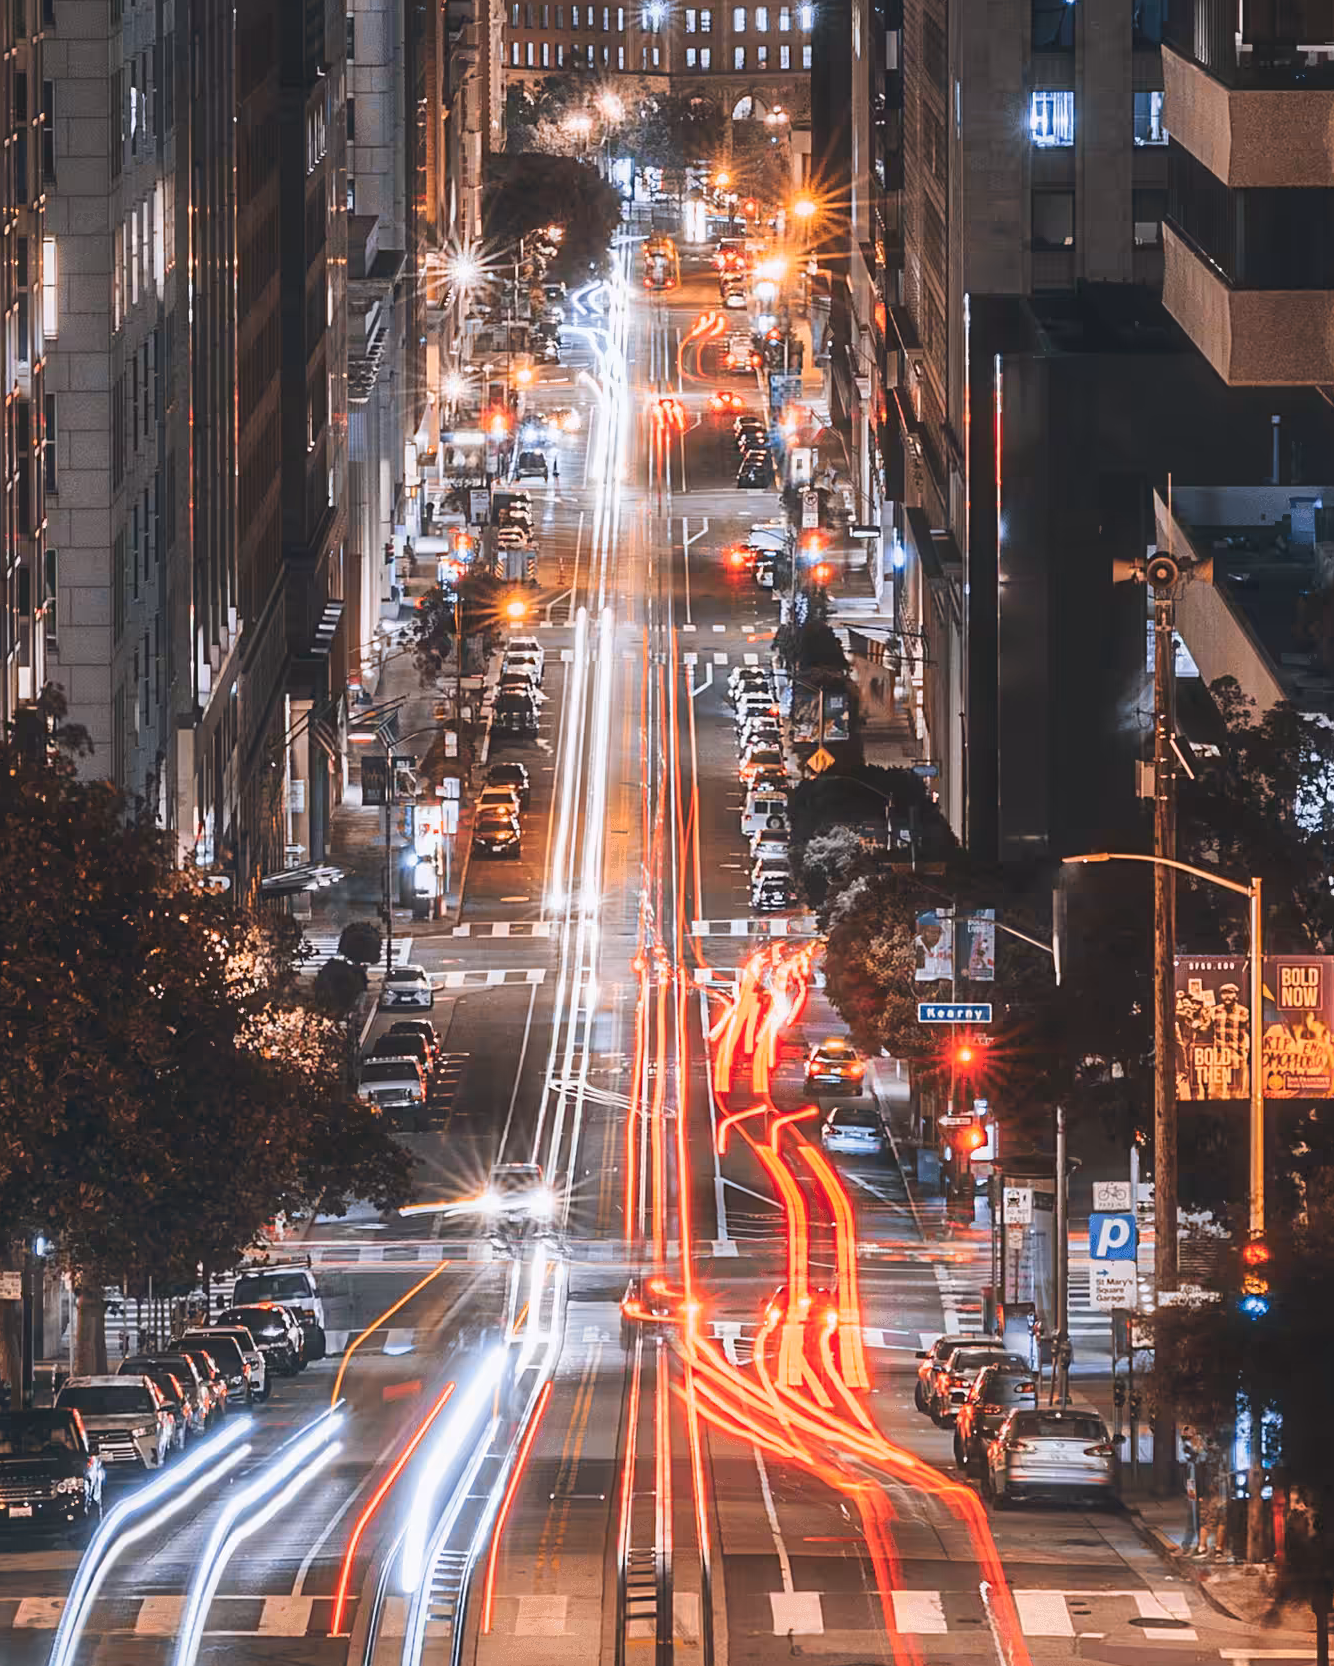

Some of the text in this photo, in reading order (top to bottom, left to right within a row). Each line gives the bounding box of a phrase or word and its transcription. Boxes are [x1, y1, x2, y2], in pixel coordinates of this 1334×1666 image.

[1282, 968, 1318, 986] BOLD
[1282, 987, 1318, 1007] NOW
[926, 1007, 983, 1020] Kearny
[1195, 1047, 1231, 1065] BOLD
[1195, 1066, 1232, 1083] THEN
